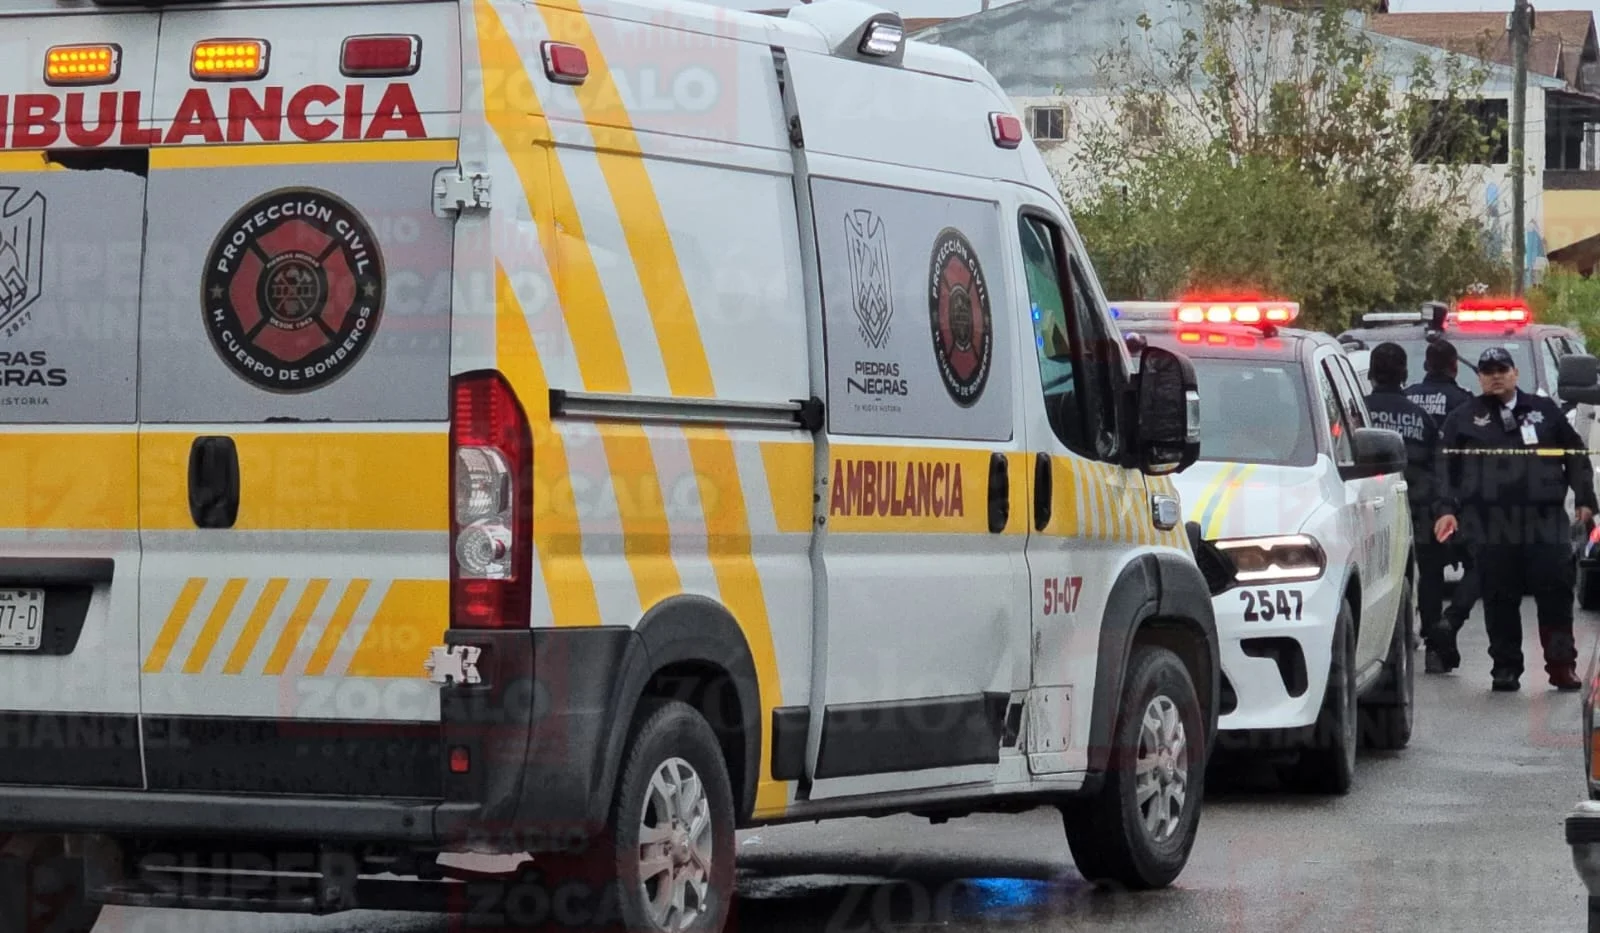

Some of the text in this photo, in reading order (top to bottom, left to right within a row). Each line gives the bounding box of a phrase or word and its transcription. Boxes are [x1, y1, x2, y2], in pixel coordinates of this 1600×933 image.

[0, 83, 427, 148] BULANCIA
[217, 200, 332, 273] PROTECCIÓN
[335, 219, 371, 275] CIVIL
[221, 330, 275, 378] CUERPO
[278, 369, 301, 381] DE
[304, 306, 371, 378] BOMBEROS
[0, 368, 68, 387] RAS
[847, 377, 908, 396] NEGRAS
[854, 360, 900, 377] PIEDRAS
[1370, 411, 1425, 429] POLICÍA
[830, 459, 964, 517] AMBULANCIA
[1043, 576, 1083, 616] 51-07
[1239, 589, 1304, 622] 2547
